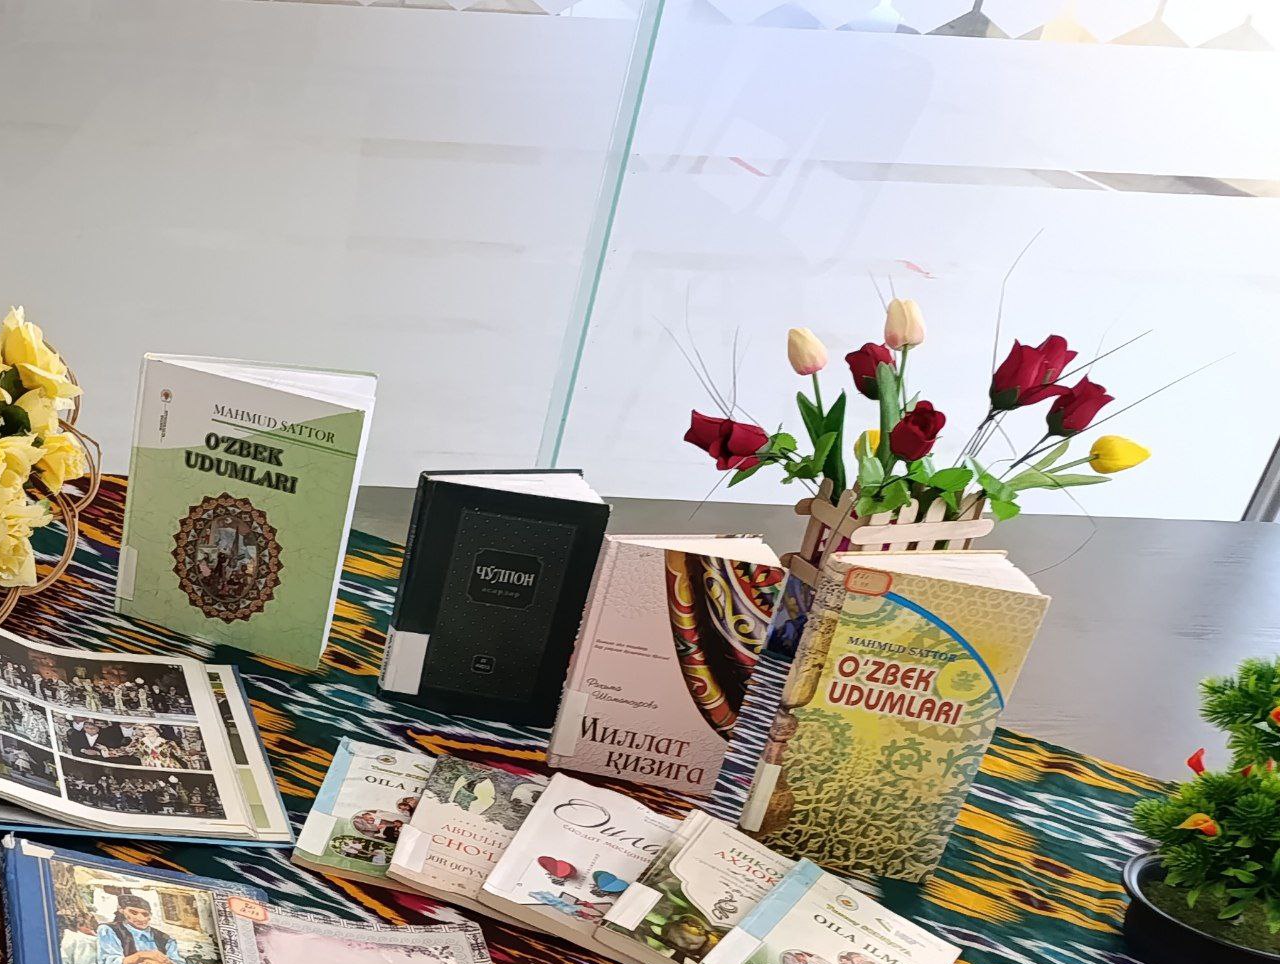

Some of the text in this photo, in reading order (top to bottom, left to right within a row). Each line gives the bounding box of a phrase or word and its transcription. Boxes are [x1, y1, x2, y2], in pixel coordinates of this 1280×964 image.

[212, 404, 335, 444] MAHMUD SATTOR
[204, 432, 284, 467] O'ZBEK
[184, 450, 299, 495] UDUMLARI
[847, 637, 959, 662] MAHMUD SATTOR
[838, 655, 936, 692] O'ZBEK
[828, 681, 964, 725] UDUMLARI
[364, 775, 407, 791] OILA
[813, 914, 857, 944] OILA
